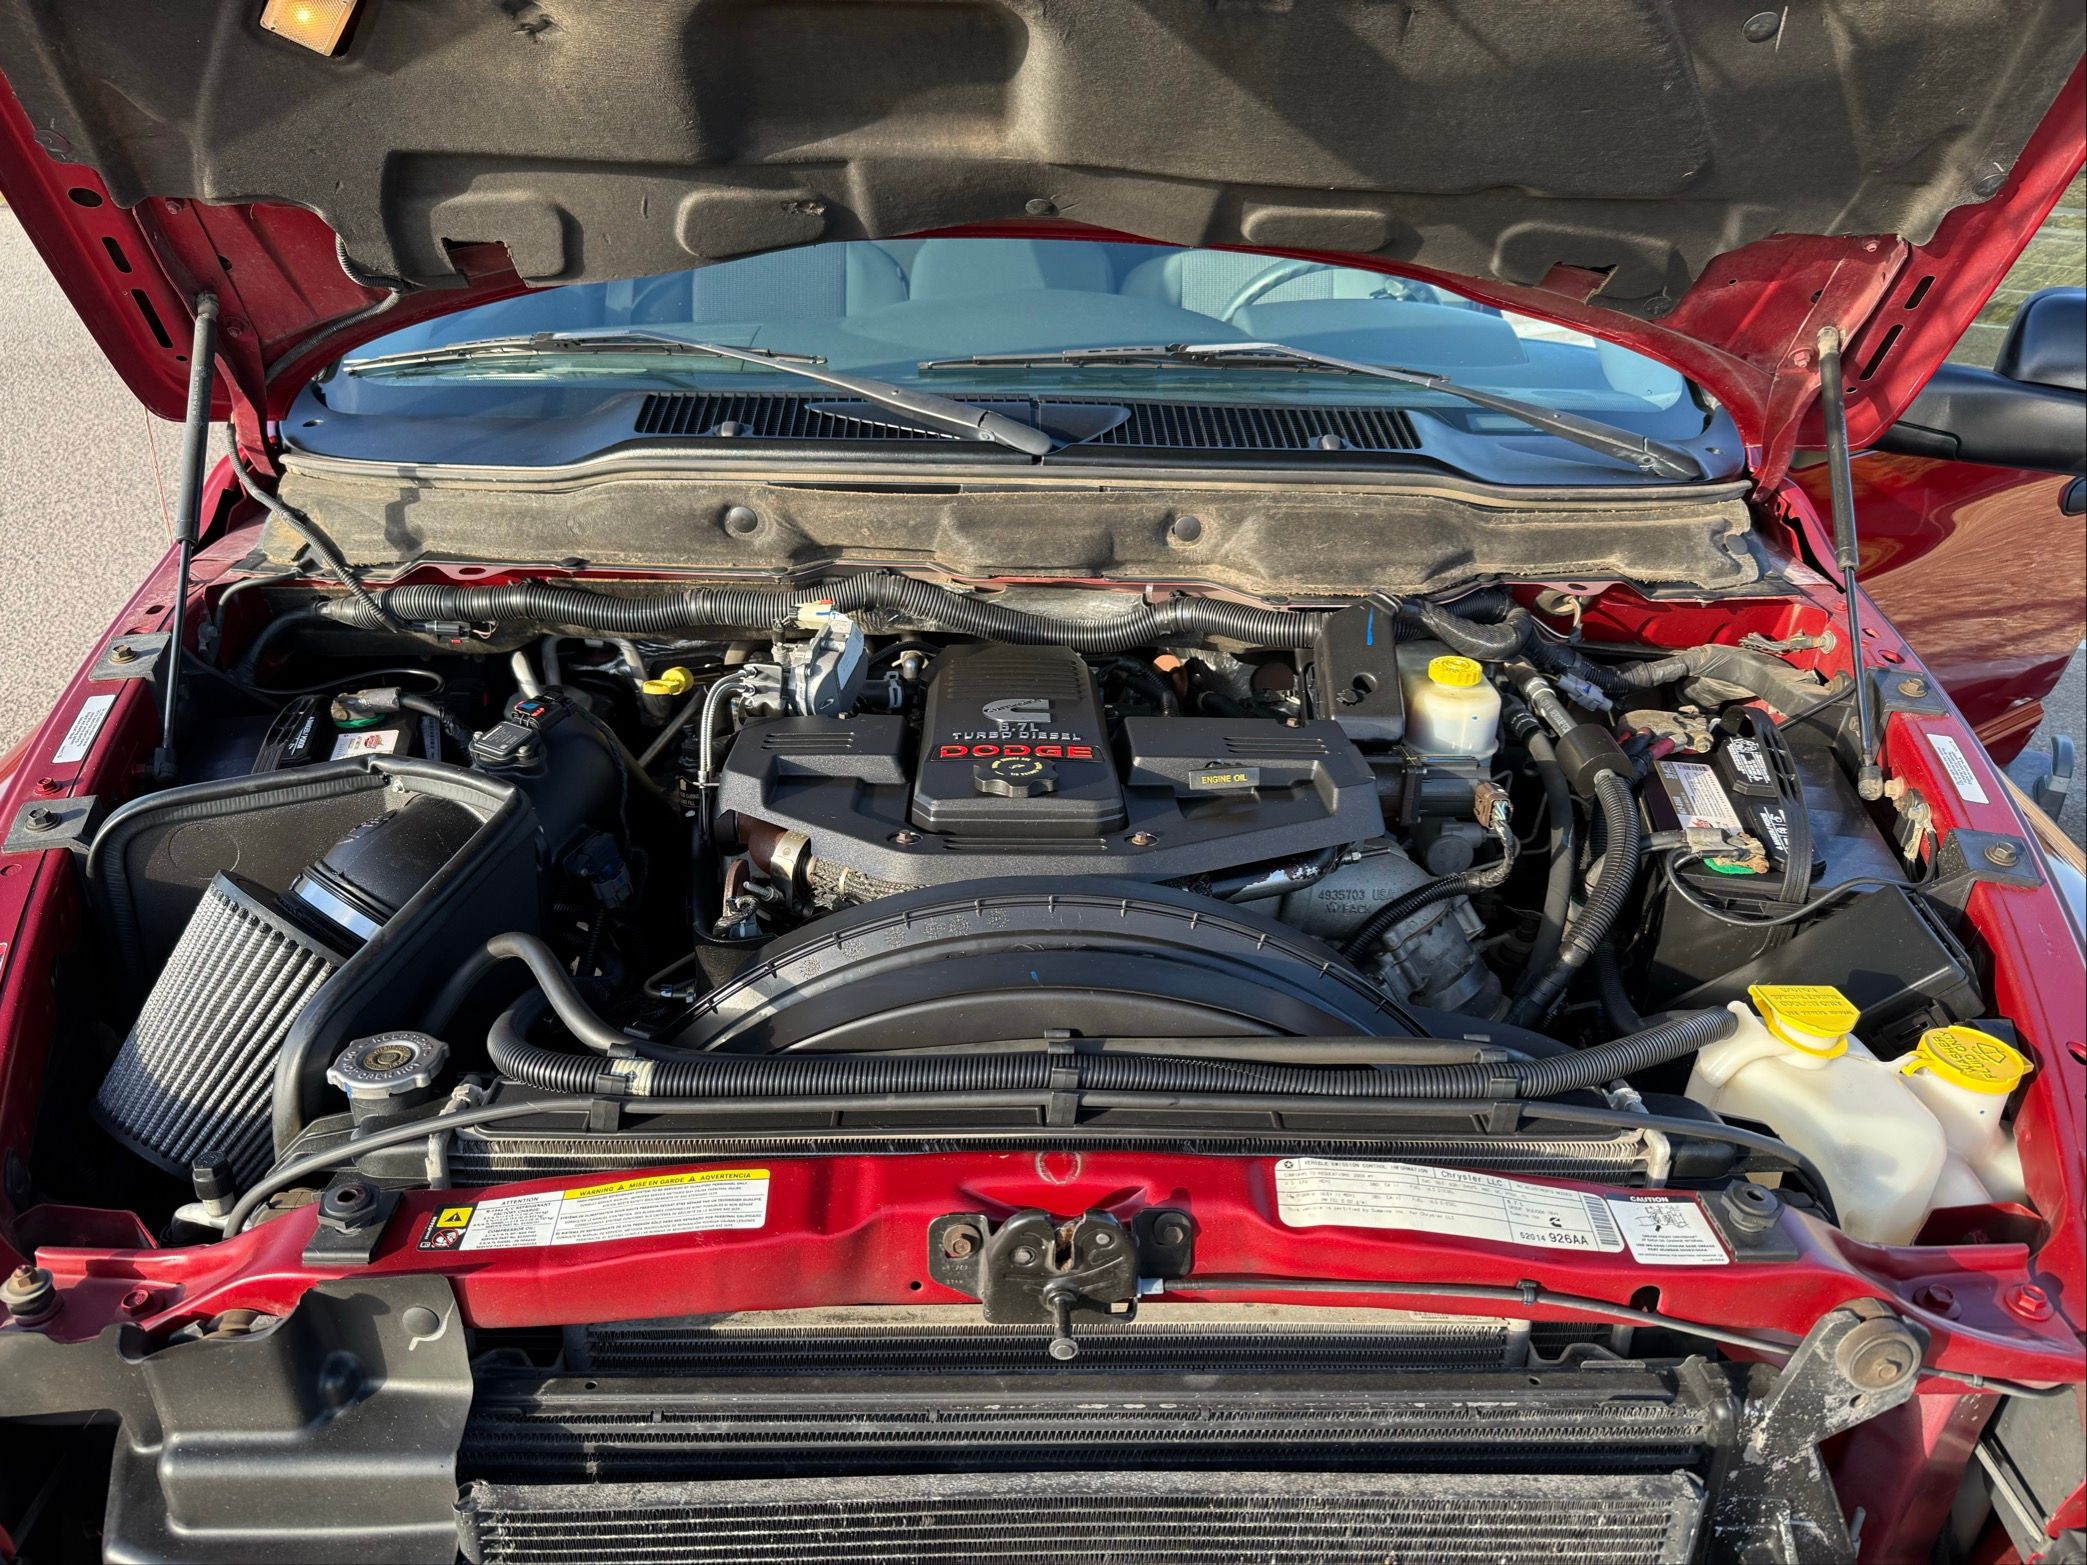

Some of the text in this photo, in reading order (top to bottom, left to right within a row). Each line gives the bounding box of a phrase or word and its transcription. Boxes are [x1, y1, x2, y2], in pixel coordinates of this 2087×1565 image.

[952, 731, 1081, 741] TURBO DIESEL
[940, 744, 1094, 759] DODGE
[1201, 773, 1249, 785] ENGINE OIL
[1318, 888, 1366, 901] 4935703
[1932, 1035, 1975, 1074] WASHER
[1935, 1031, 1997, 1080] FLUID ONLY
[579, 1186, 614, 1197] WARNING
[628, 1181, 647, 1189] MISE
[659, 1177, 685, 1185] GARDE
[700, 1172, 751, 1181] ADVERTENCIA
[1441, 1170, 1504, 1187] Chrysler LLC
[501, 1196, 540, 1206] ATTENTION
[1629, 1195, 1669, 1203] CAUTION
[1519, 1231, 1590, 1246] 52014 926AA
